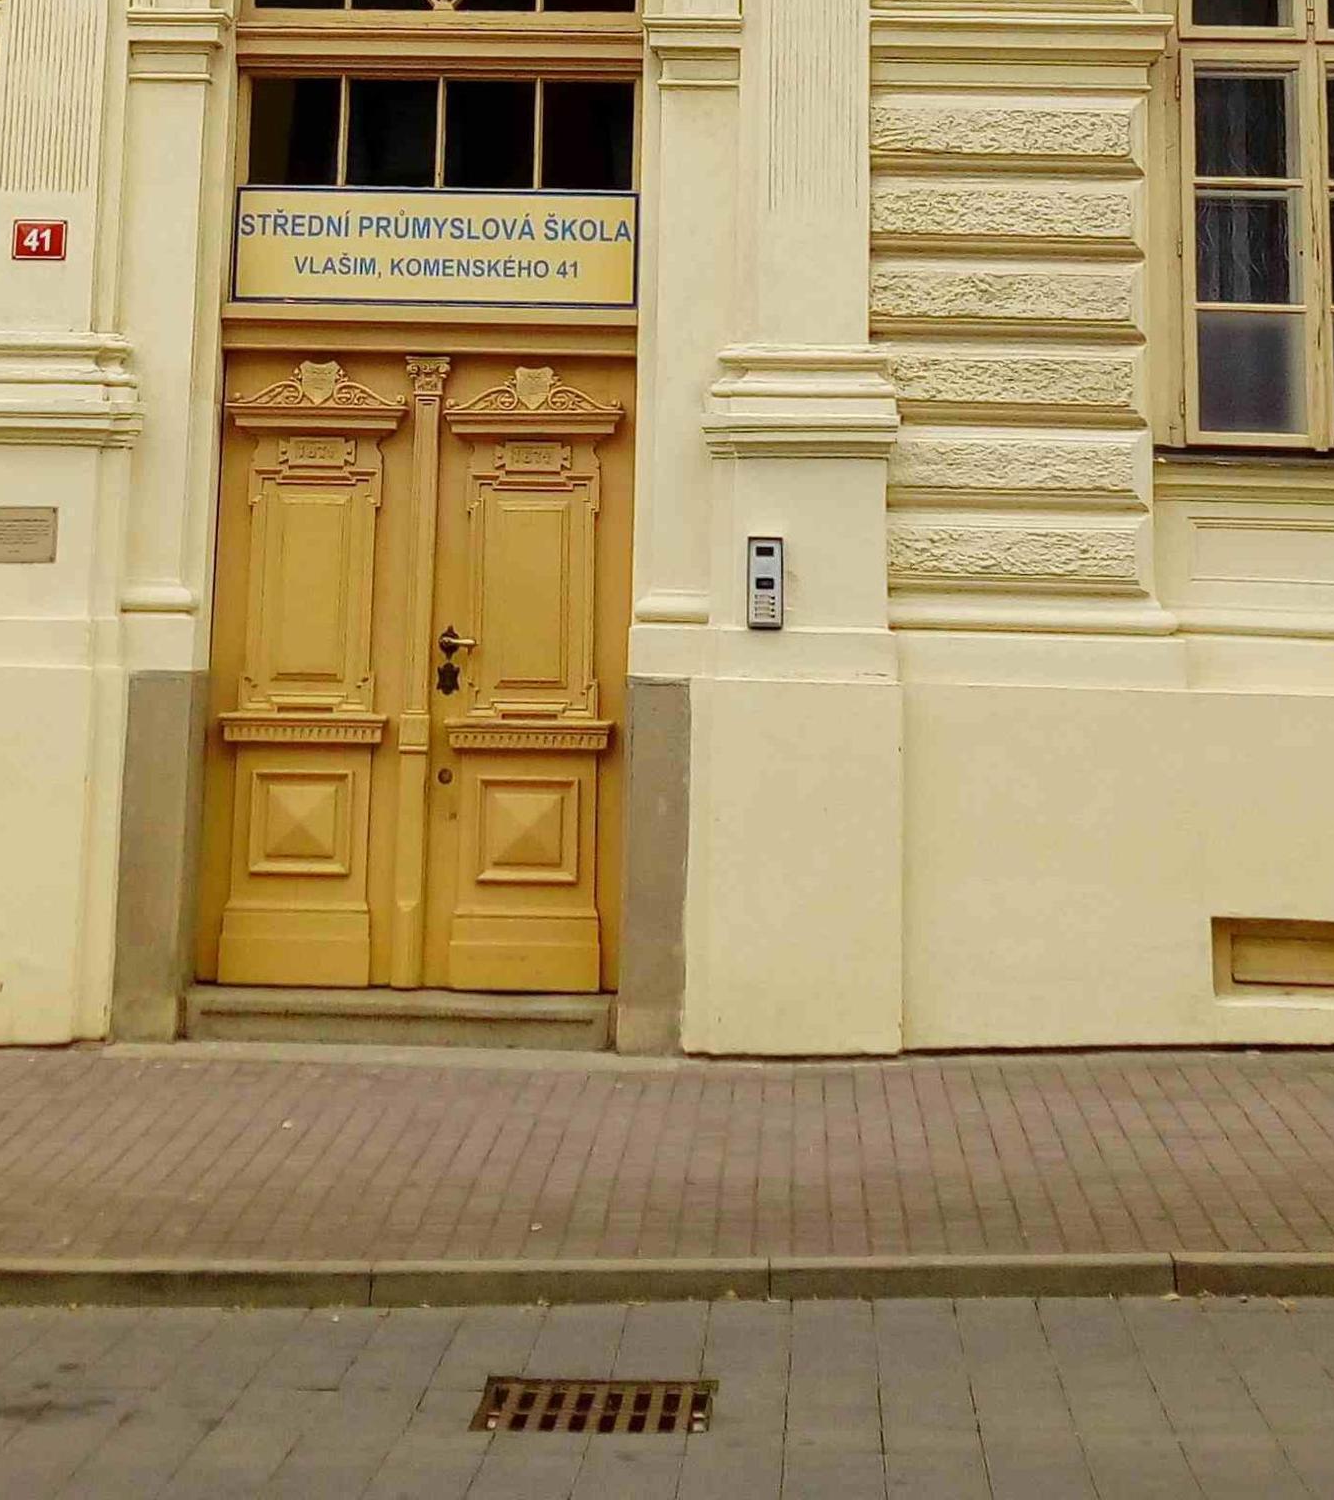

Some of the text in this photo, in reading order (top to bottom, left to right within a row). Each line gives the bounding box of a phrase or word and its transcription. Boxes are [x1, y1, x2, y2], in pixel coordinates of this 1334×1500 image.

[240, 208, 632, 242] STŘEDNÍ PRŮMYSLOVÁ ŠKOLA
[23, 228, 52, 252] 41
[294, 252, 579, 280] VLAŠIM, KOMENSKÉHO 41
